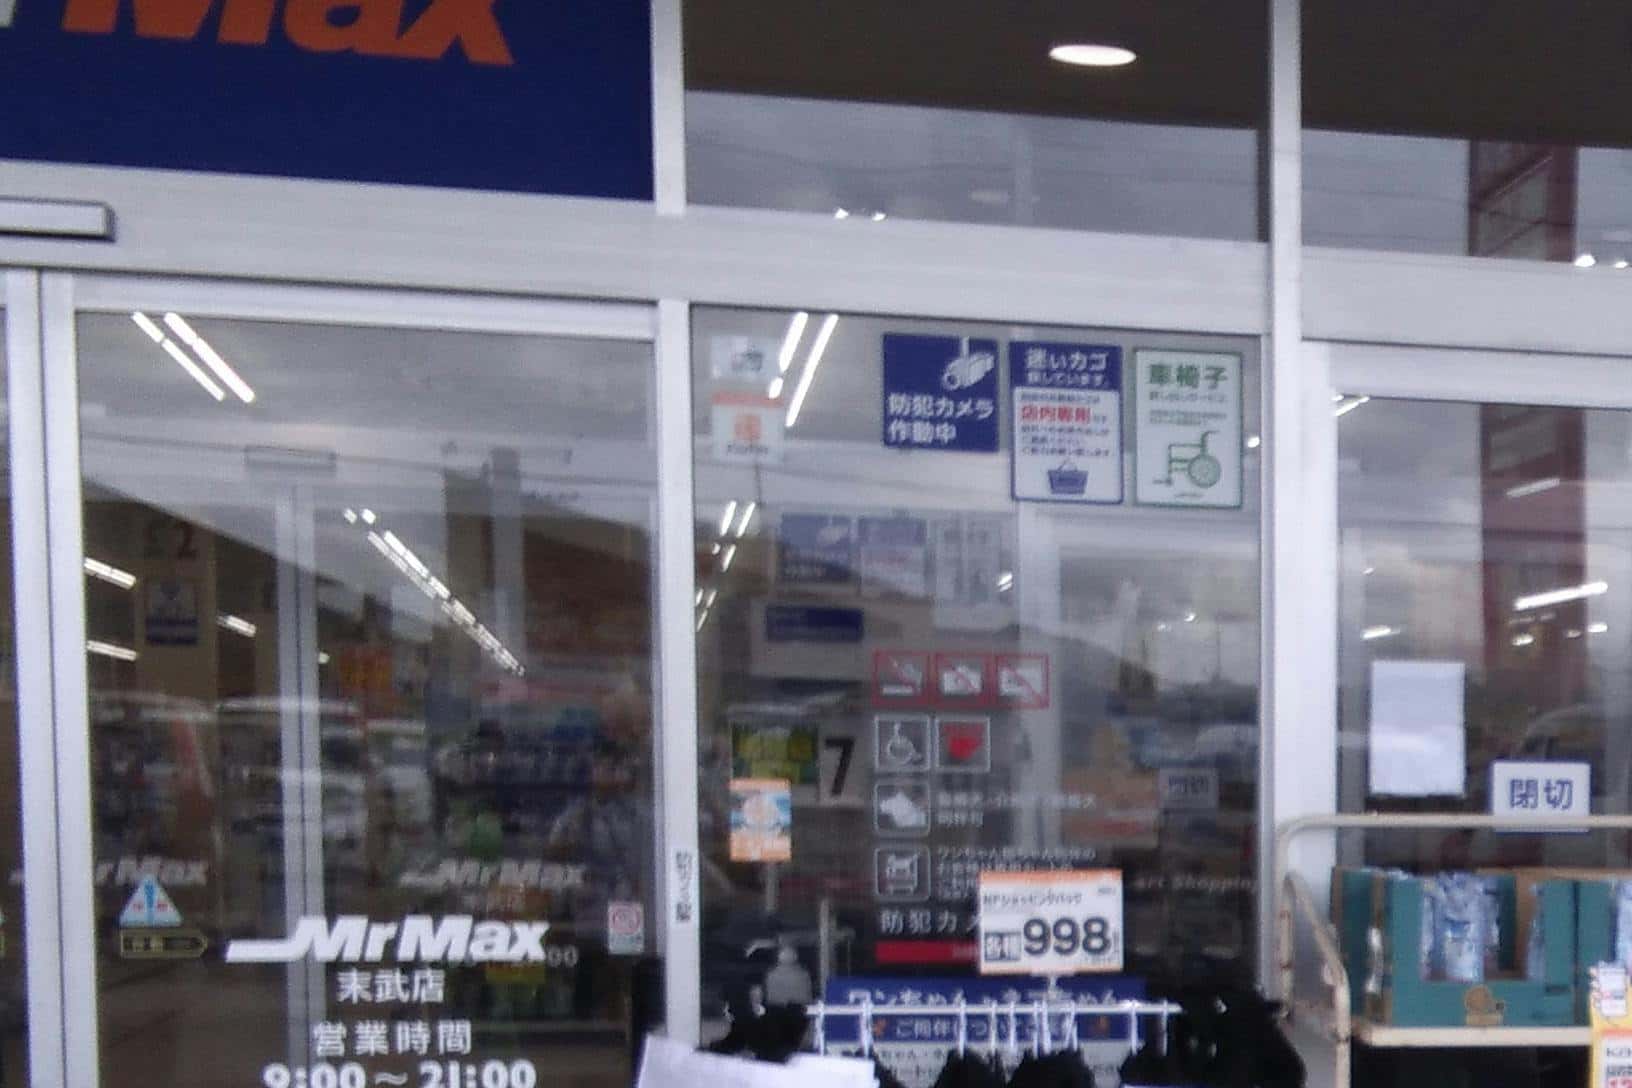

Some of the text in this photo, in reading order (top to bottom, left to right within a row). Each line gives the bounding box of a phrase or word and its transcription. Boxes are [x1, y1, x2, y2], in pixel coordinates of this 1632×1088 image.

[888, 392, 995, 421] 防犯カメラ
[888, 418, 958, 444] 作動中
[1510, 778, 1574, 810] 閉切
[290, 914, 550, 963] MrMax
[1023, 916, 1112, 956] 998
[336, 967, 446, 1004] 末武店
[312, 1019, 473, 1058] 営業時間
